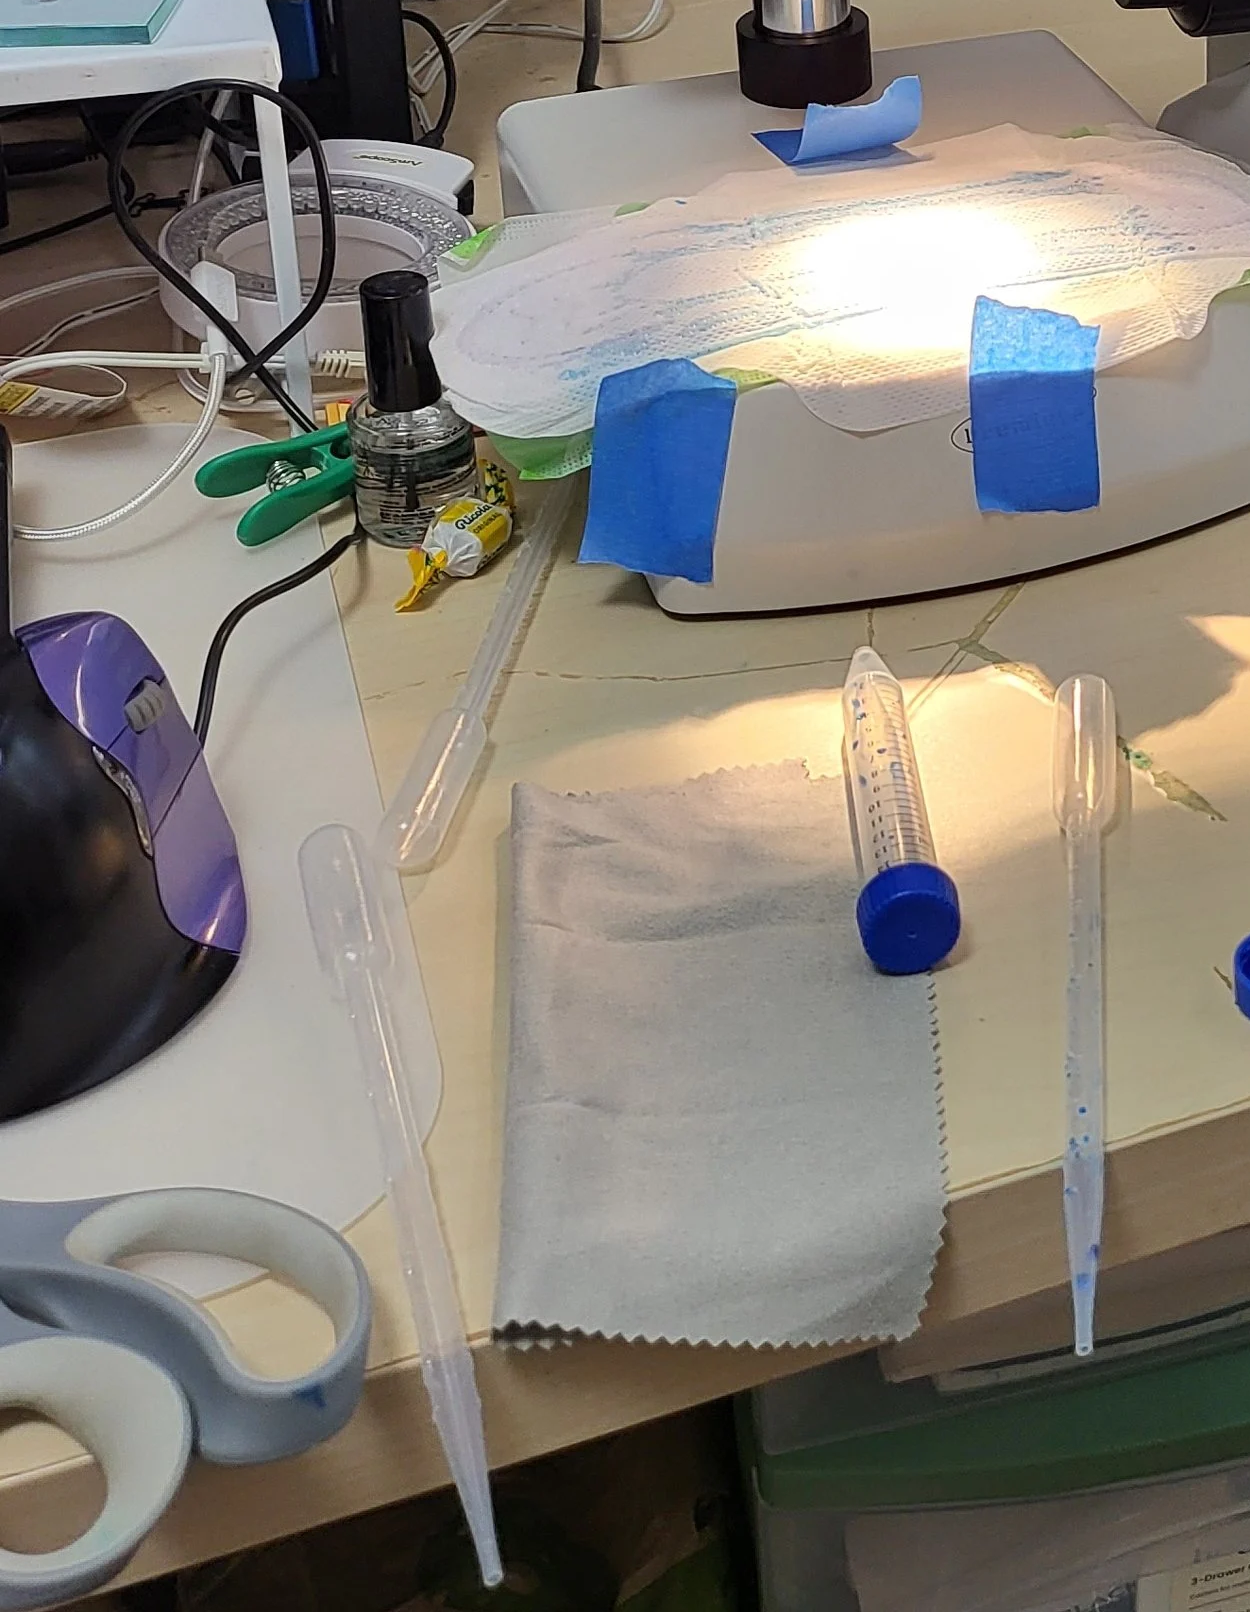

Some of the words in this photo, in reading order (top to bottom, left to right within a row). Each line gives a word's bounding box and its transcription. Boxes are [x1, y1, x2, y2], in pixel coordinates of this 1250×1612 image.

[359, 155, 423, 166] AmScope
[455, 502, 493, 530] Ricola
[1190, 1565, 1246, 1586] 3-Drawer
